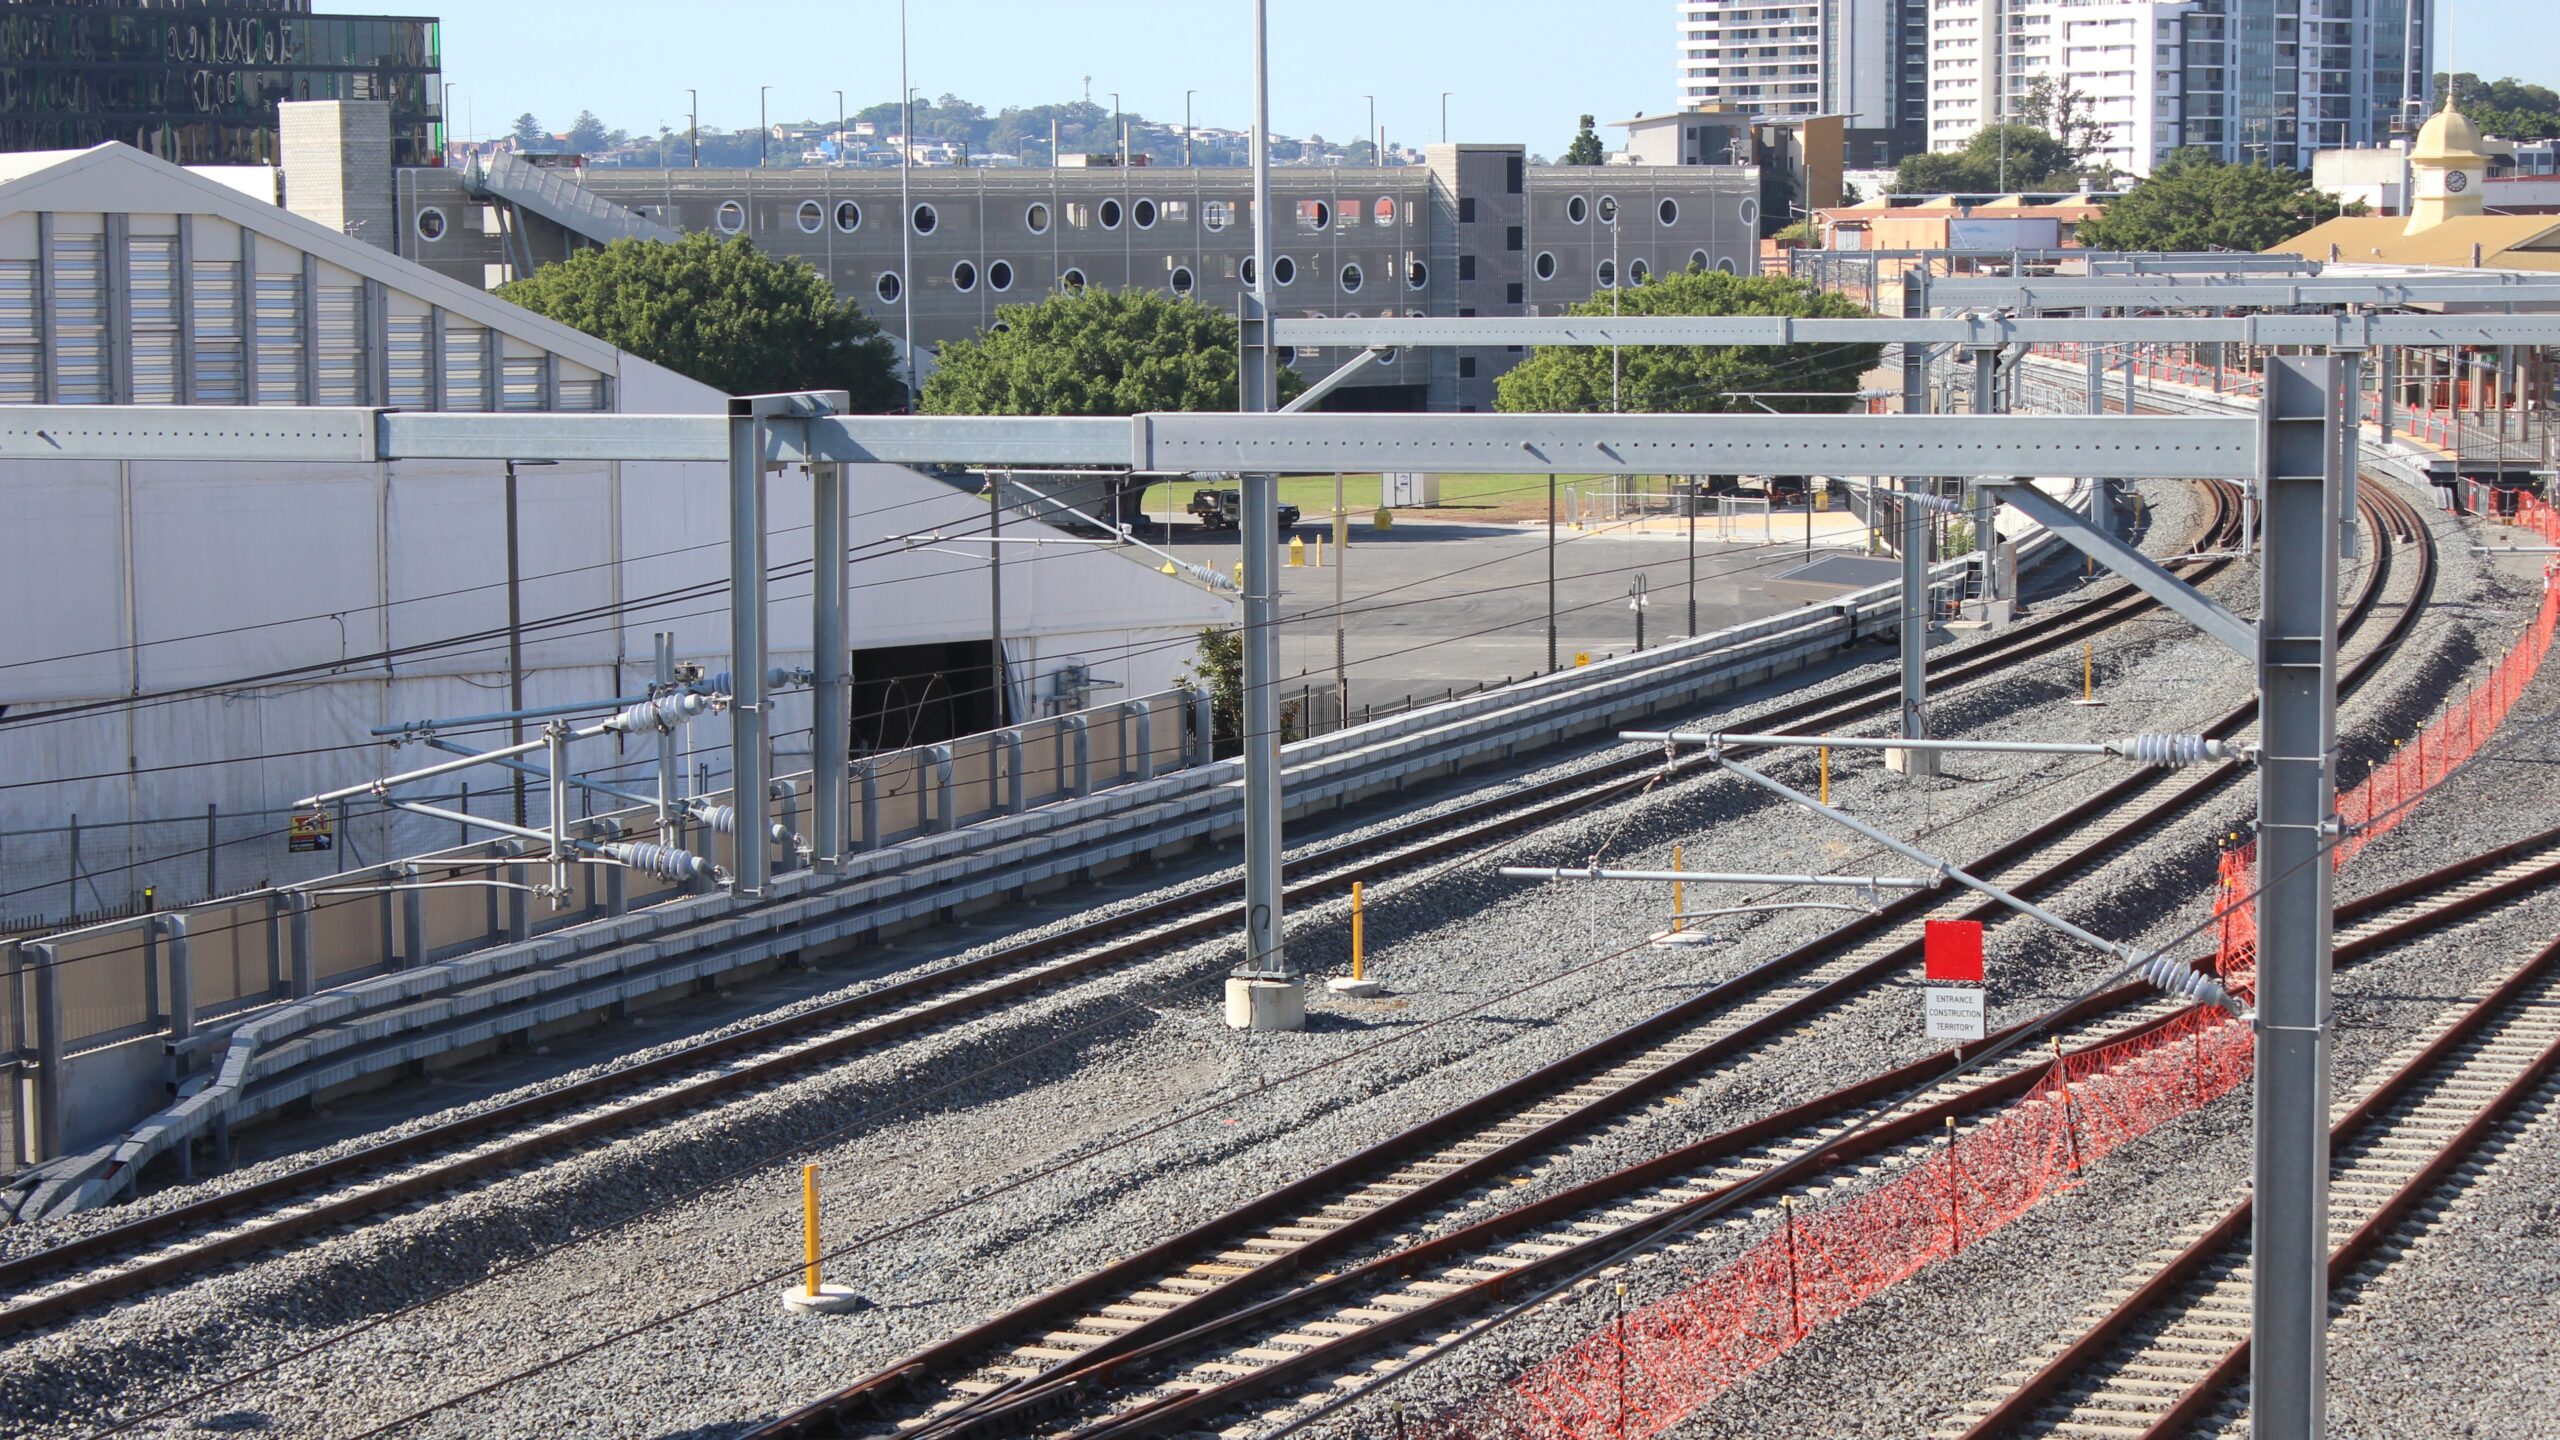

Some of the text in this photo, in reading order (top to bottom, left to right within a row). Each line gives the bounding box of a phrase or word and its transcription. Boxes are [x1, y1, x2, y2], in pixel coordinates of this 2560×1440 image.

[1936, 995, 1974, 1004] ENTRANCE
[1929, 1008, 1982, 1018] CONSTRUCTION
[1936, 1022, 1974, 1032] TERRITORY
